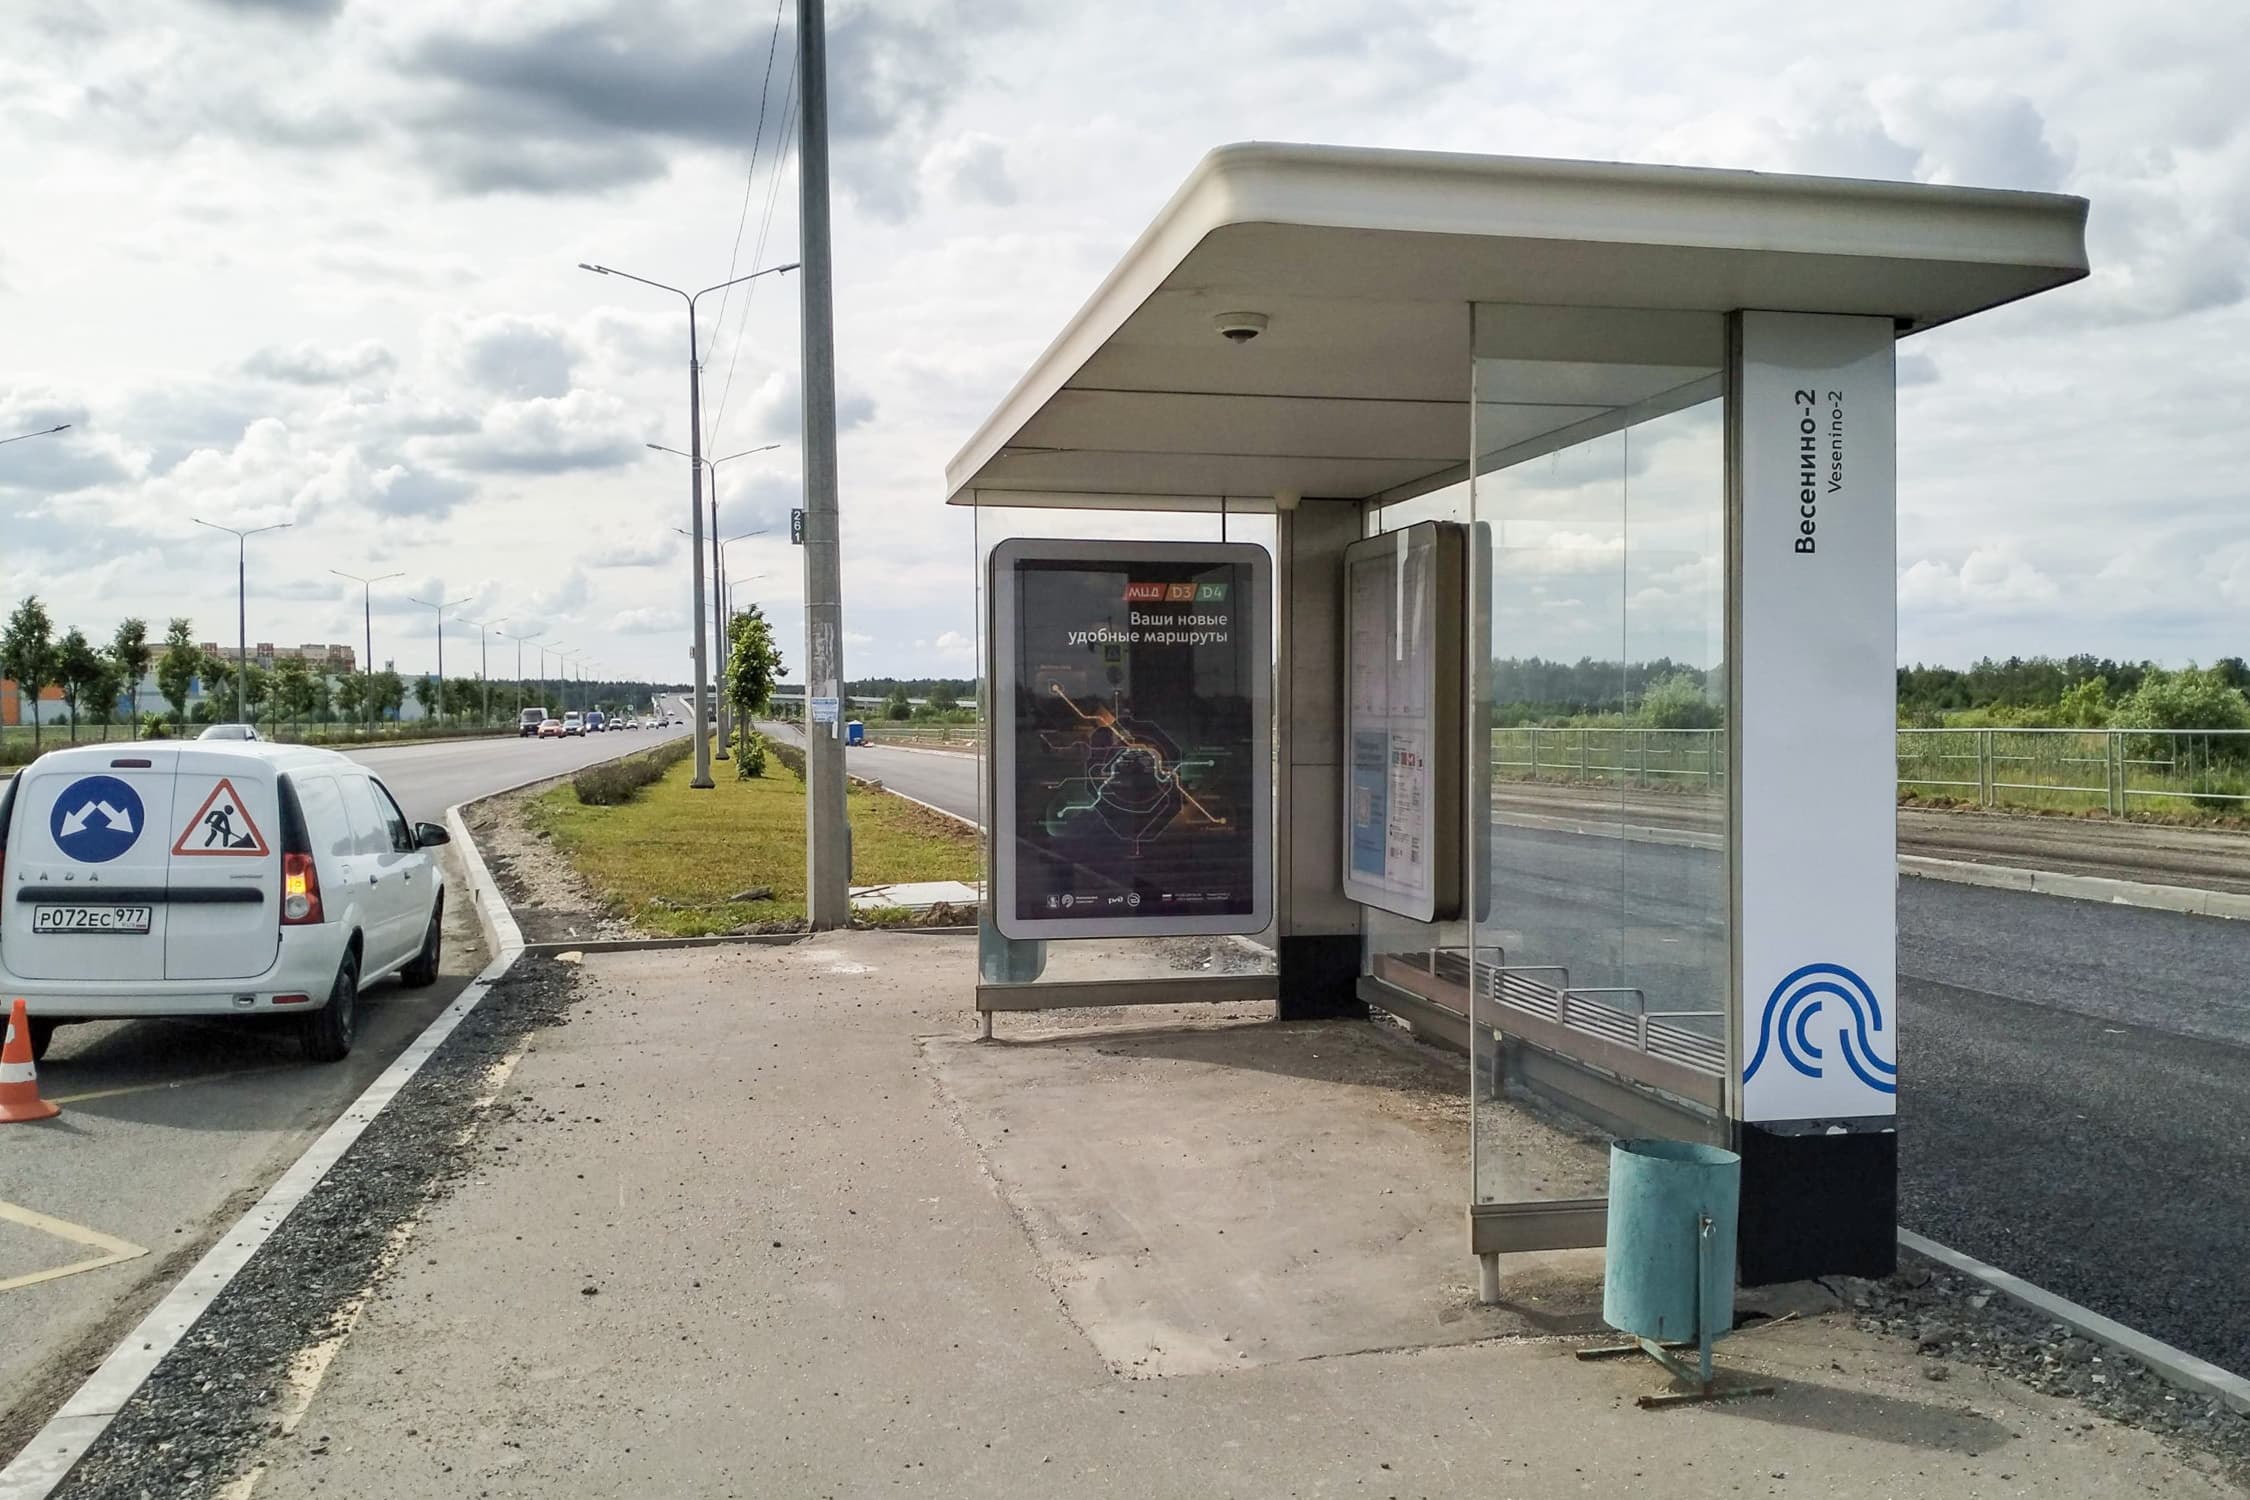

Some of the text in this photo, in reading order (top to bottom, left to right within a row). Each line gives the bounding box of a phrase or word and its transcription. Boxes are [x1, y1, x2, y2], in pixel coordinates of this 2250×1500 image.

[1828, 391, 1842, 493] Vesenino-2
[1795, 389, 1816, 553] Весенино-2
[1172, 586, 1191, 598] D3
[1202, 586, 1222, 598] D4
[1130, 612, 1228, 625] Ваши новые
[1068, 627, 1228, 645] удобные маршруты
[116, 908, 144, 922] 977
